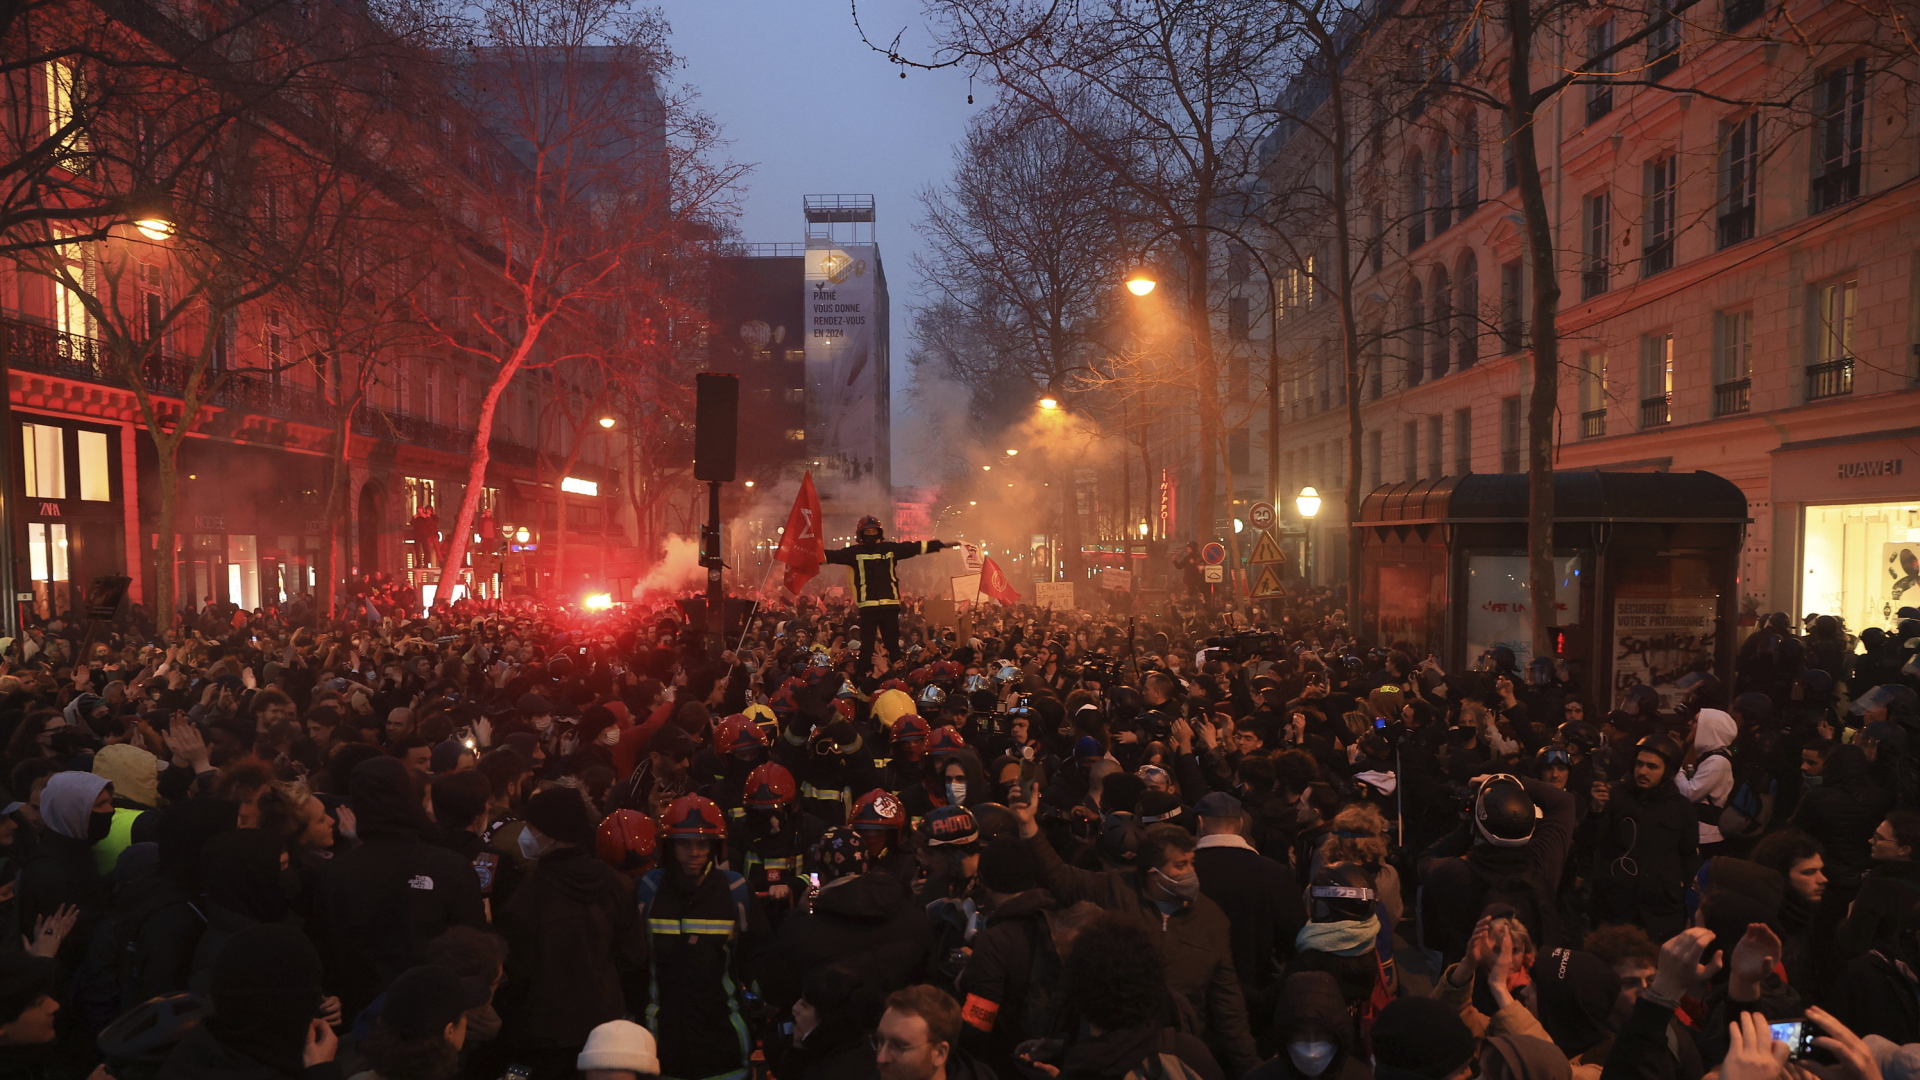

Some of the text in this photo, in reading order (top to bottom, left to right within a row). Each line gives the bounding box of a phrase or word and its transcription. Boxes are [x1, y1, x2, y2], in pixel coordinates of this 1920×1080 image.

[813, 290, 837, 301] PATHÉ
[813, 303, 860, 313] VOUS DONNE
[814, 316, 865, 326] RENDEZ-VOUS
[814, 329, 844, 338] EN 2024
[1837, 459, 1902, 478] HUAWEI
[1160, 482, 1168, 519] HIPPO
[40, 502, 61, 516] ZARA
[1618, 601, 1667, 615] SÉCURISEZ
[1617, 615, 1647, 627] VOTRE
[1649, 615, 1705, 627] PATRIMOINE
[932, 814, 973, 835] PHOTO
